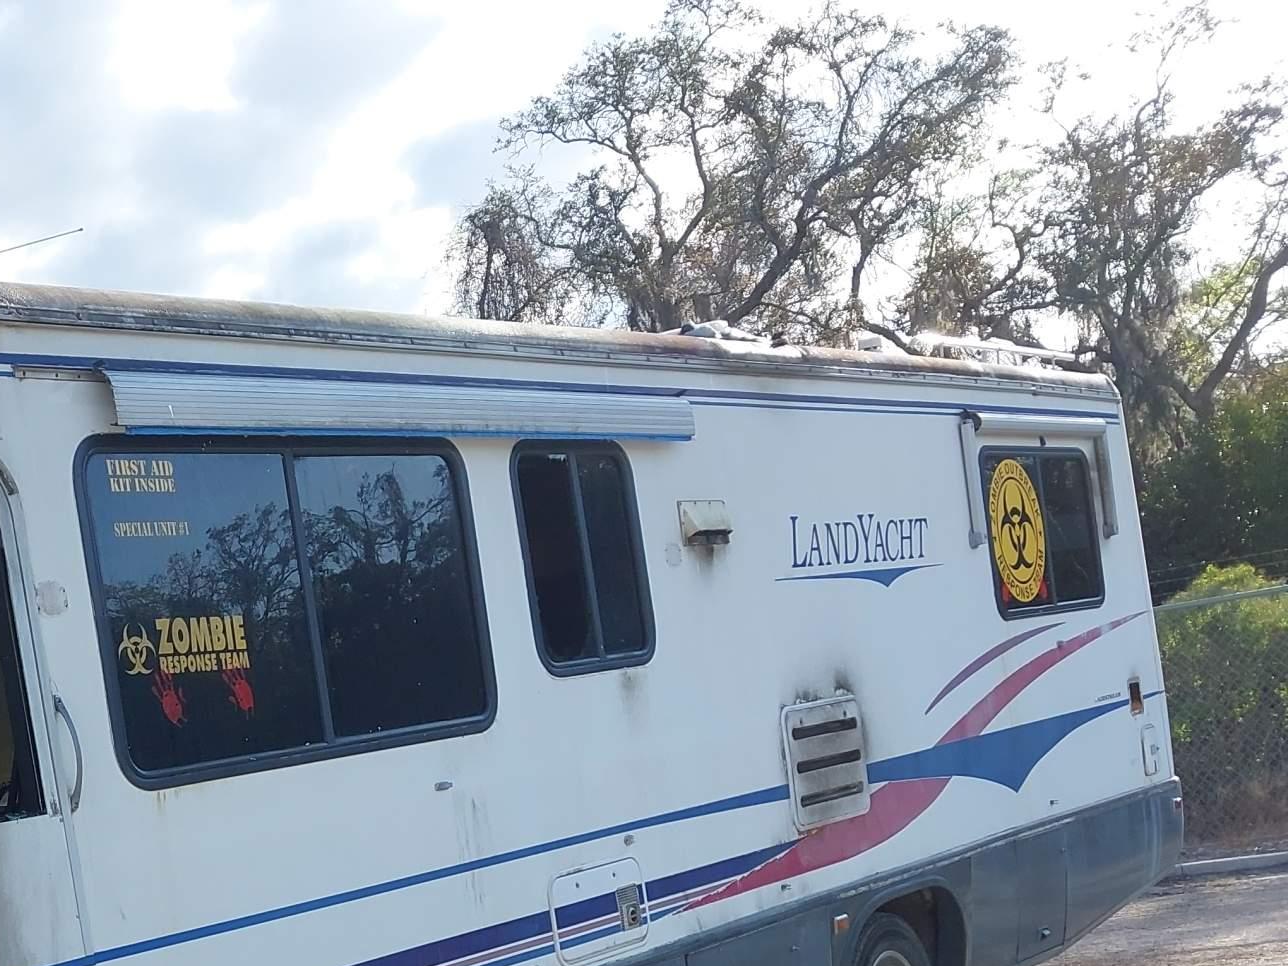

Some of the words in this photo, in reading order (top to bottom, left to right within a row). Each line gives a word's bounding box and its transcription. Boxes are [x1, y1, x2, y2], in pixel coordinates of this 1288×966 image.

[106, 459, 146, 476] FIRST
[151, 460, 174, 476] AID
[110, 478, 131, 492] KIT
[134, 478, 176, 493] INSIDE
[114, 521, 154, 537] SPECIAL
[154, 520, 178, 536] UNIT
[179, 520, 190, 536] #1
[155, 615, 247, 654] ZOMBIE
[159, 653, 218, 674] RESPONSE
[219, 651, 250, 670] TEAM
